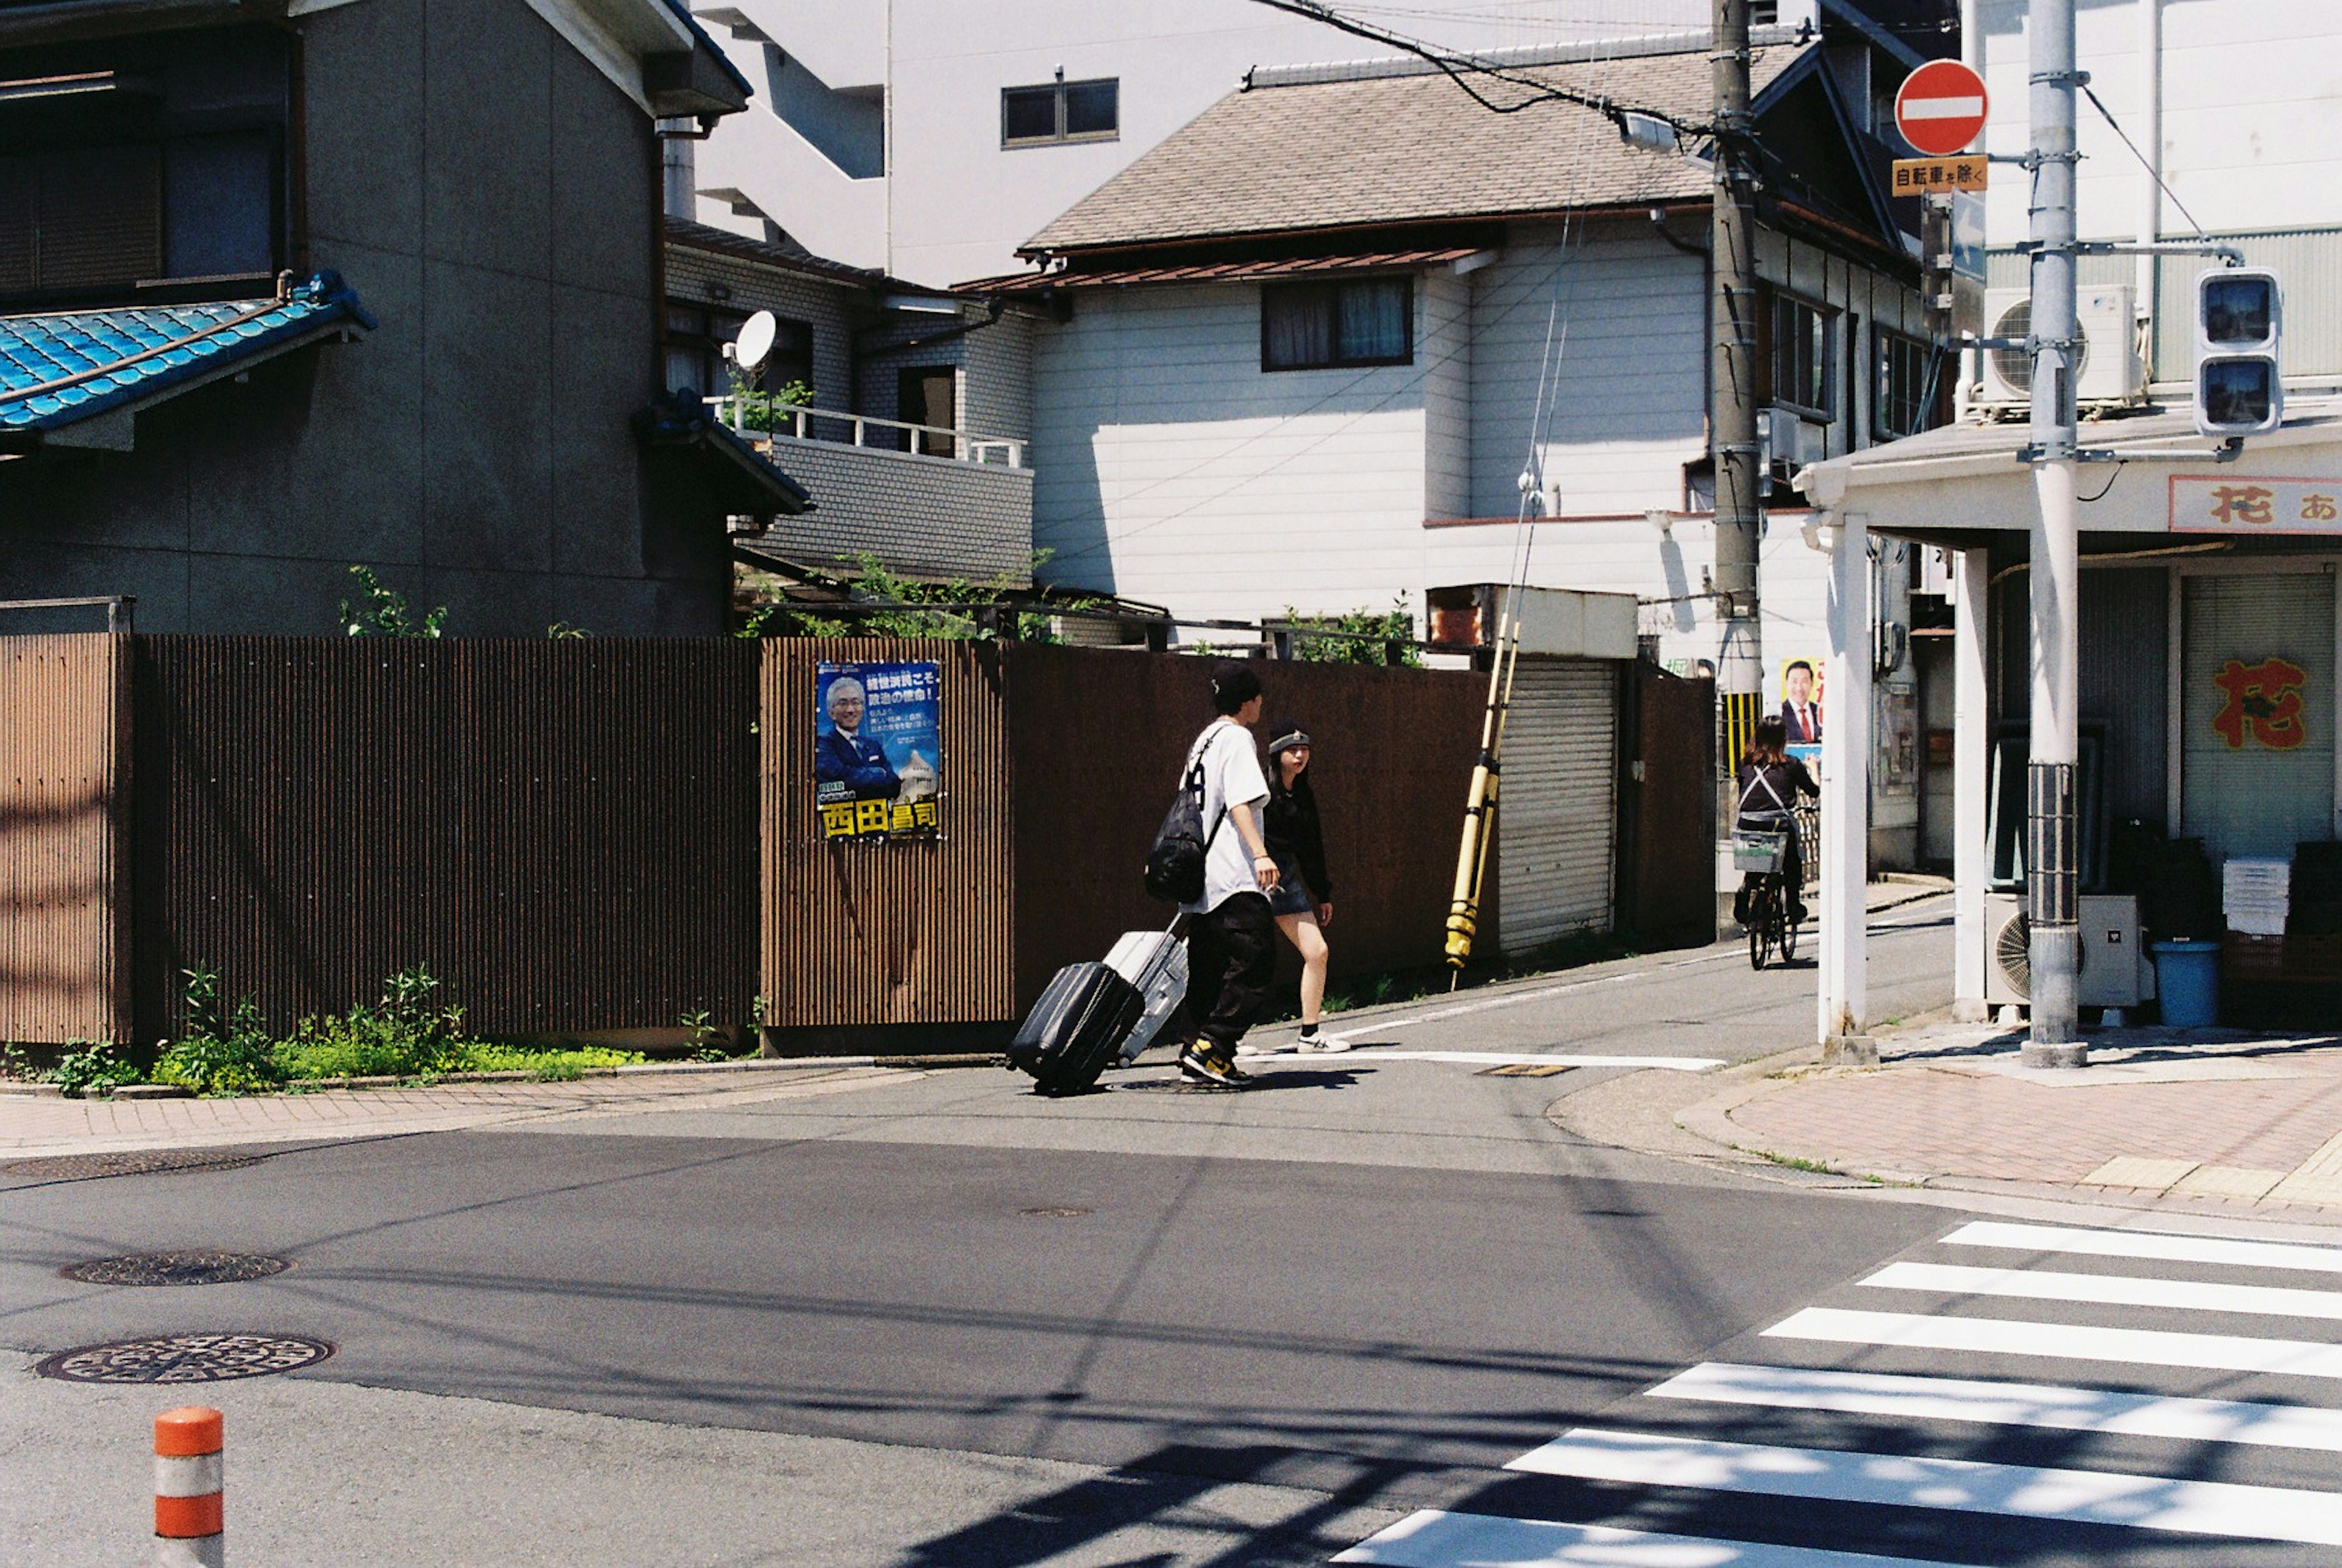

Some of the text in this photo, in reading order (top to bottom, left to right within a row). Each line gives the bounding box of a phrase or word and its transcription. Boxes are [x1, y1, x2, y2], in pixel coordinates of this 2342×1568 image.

[1897, 164, 1982, 186] 自転車を除く
[2210, 486, 2337, 524] 花 あ
[2212, 657, 2307, 752] 花
[821, 798, 937, 837] 西田昌司
